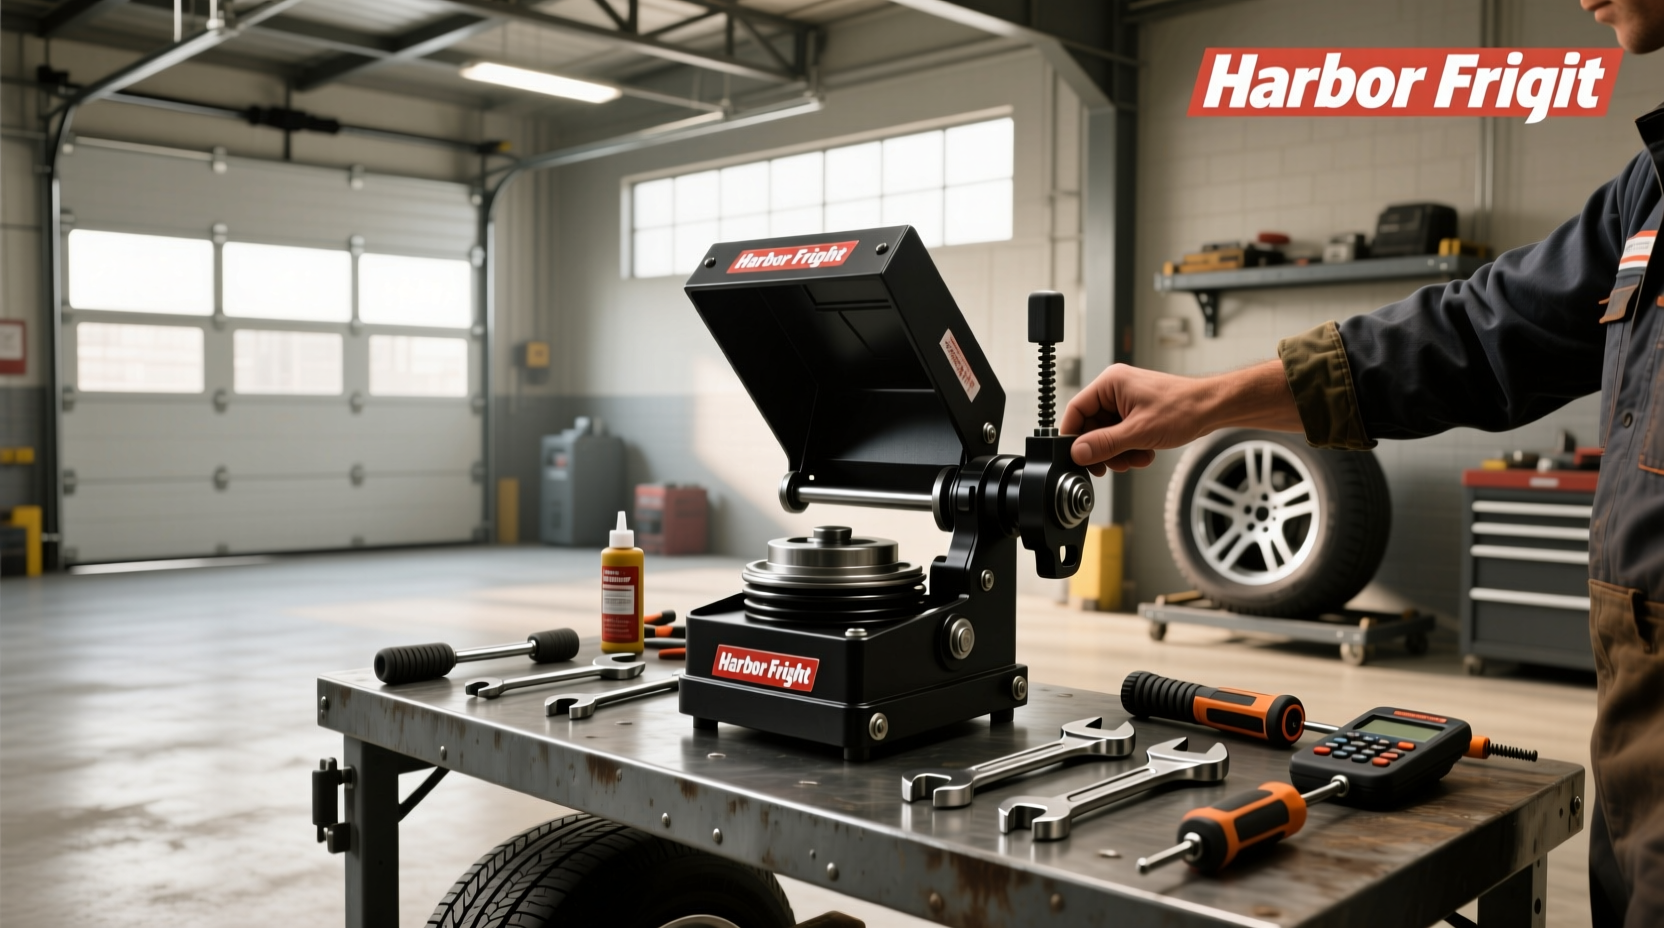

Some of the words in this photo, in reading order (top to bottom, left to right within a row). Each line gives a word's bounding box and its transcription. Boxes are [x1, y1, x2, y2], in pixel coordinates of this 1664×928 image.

[734, 251, 793, 269] Harbor
[718, 651, 768, 677] Harbor
[767, 659, 811, 688] Fright
